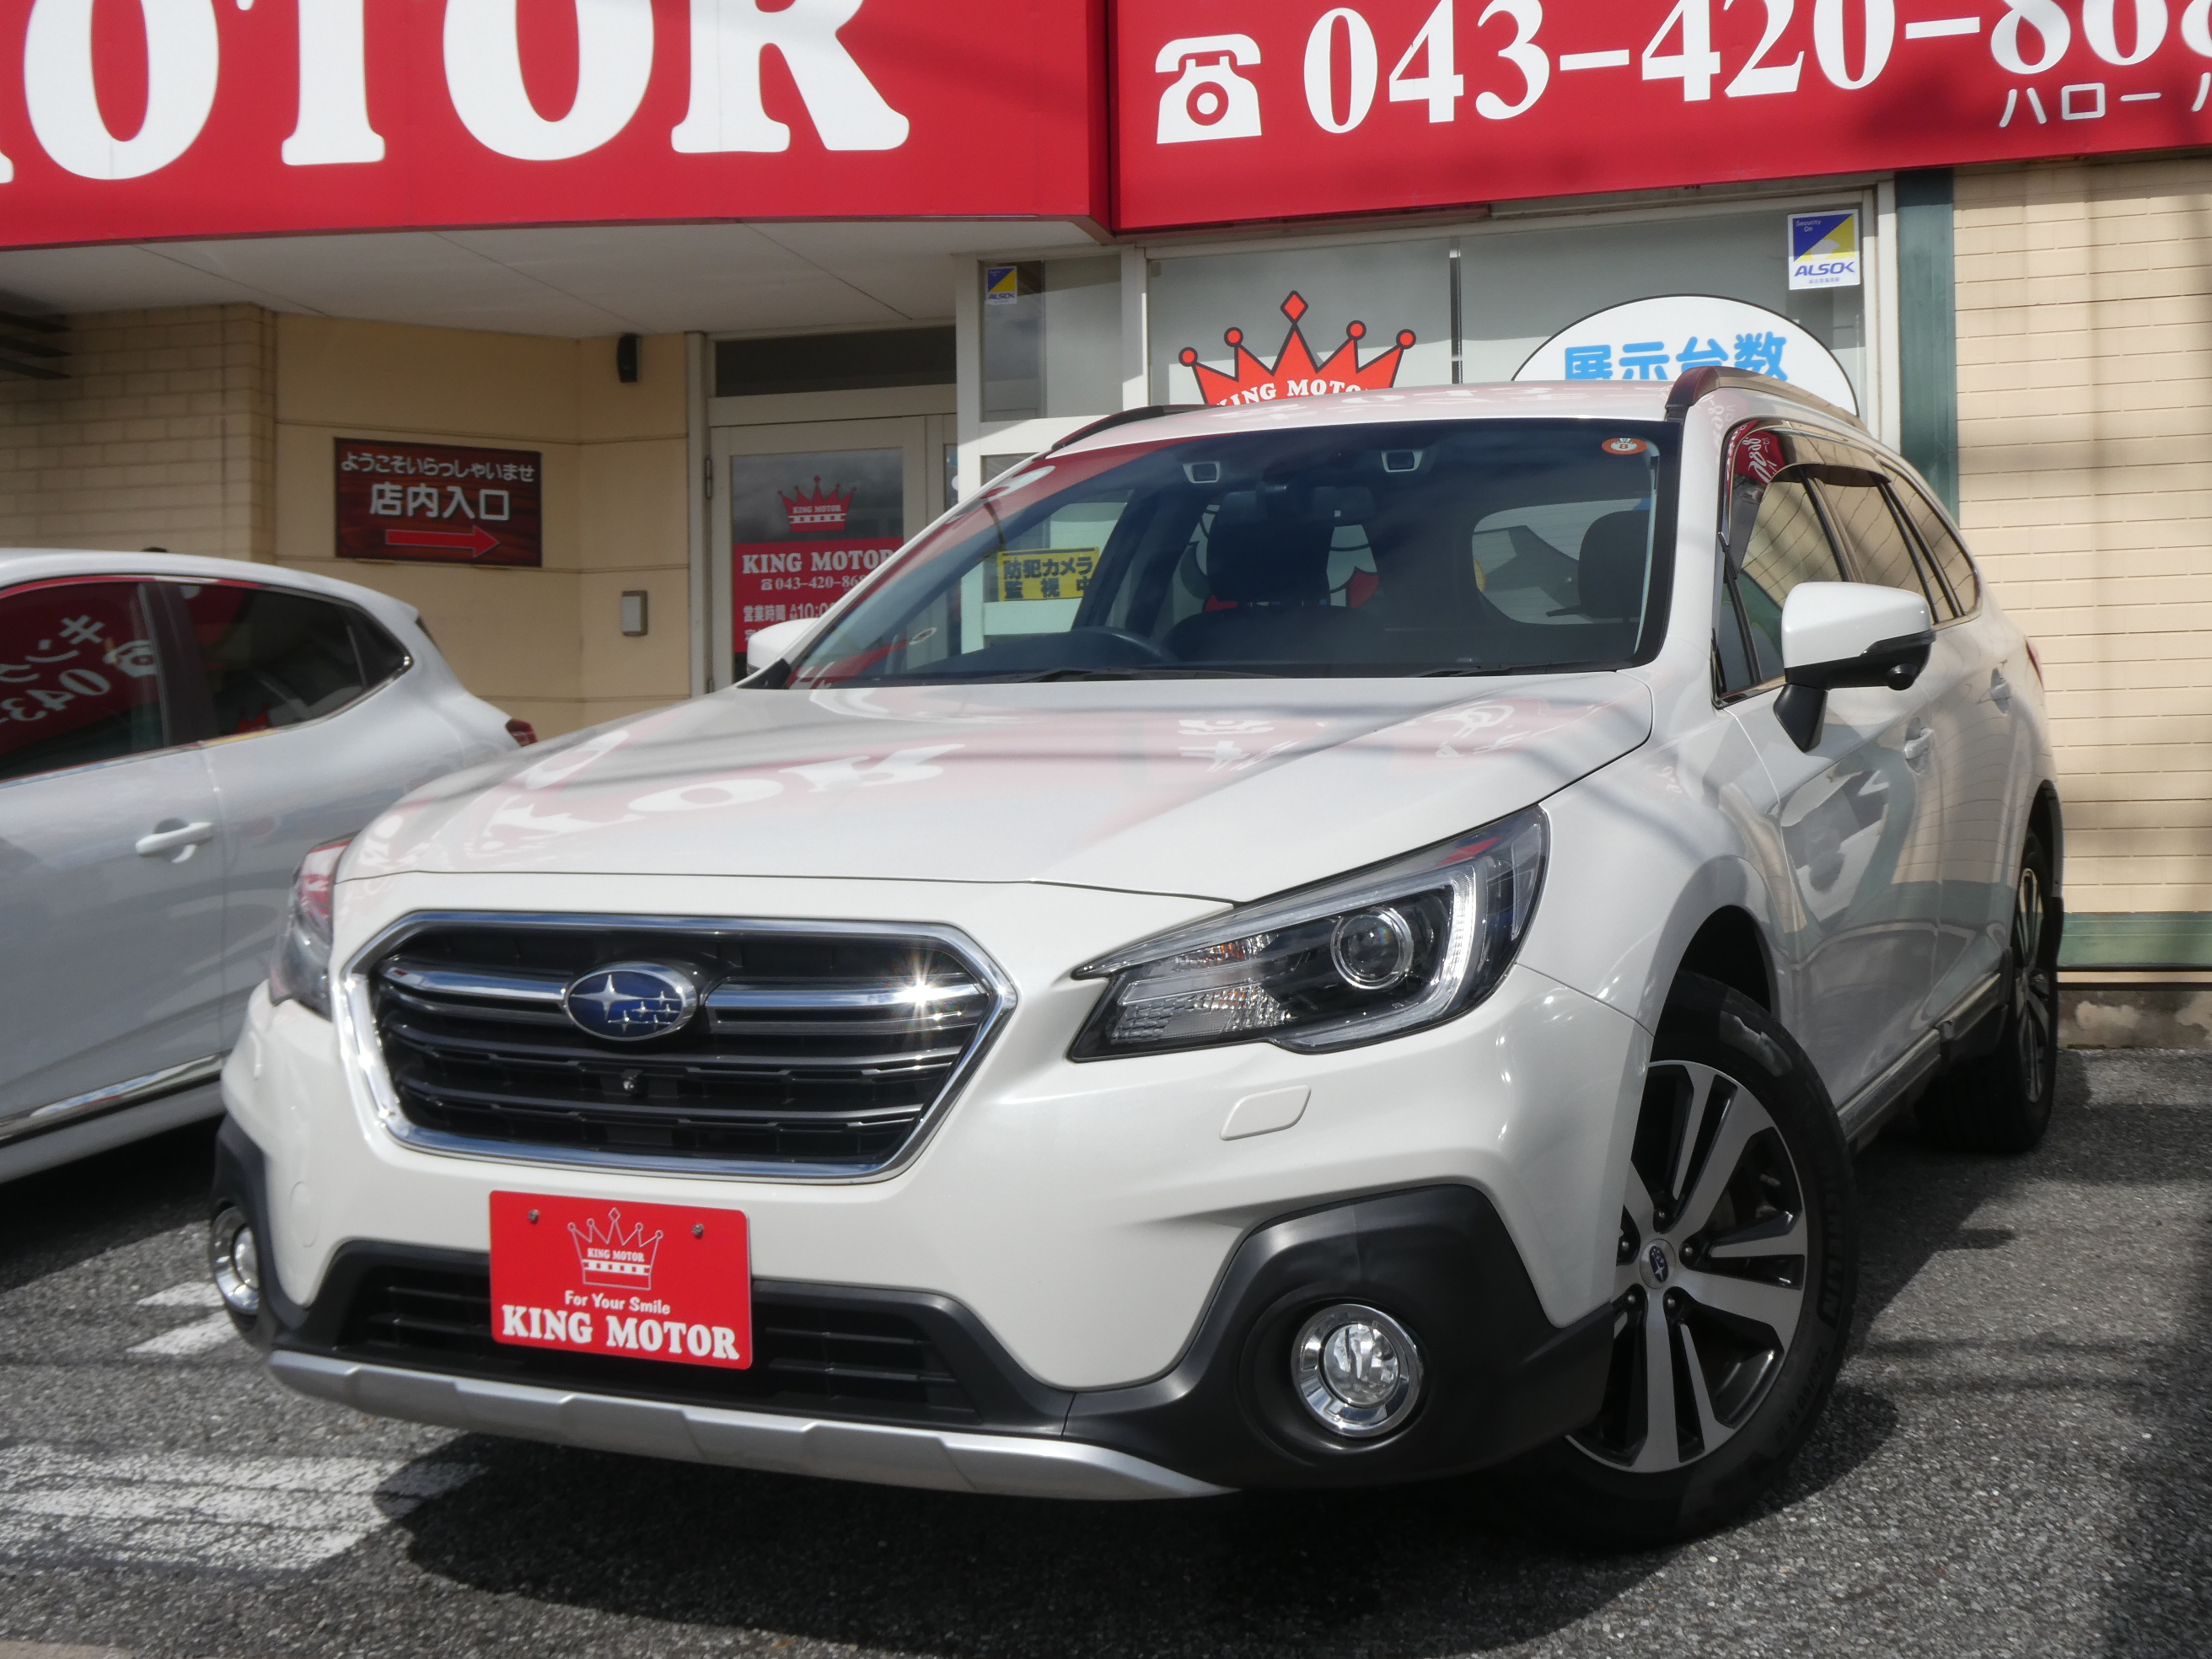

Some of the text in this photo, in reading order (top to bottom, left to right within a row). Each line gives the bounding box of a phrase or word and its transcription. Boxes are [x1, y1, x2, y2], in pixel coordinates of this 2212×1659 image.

[0, 0, 910, 183] OTOR
[1794, 261, 1855, 277] ALSOK
[368, 481, 511, 522] 店内入口
[742, 553, 803, 575] KING
[1002, 556, 1094, 581] 防犯カメラ
[587, 1247, 645, 1263] KING MOTOR
[564, 1290, 671, 1315] For Your Smile
[502, 1304, 740, 1360] KING MOTOR
